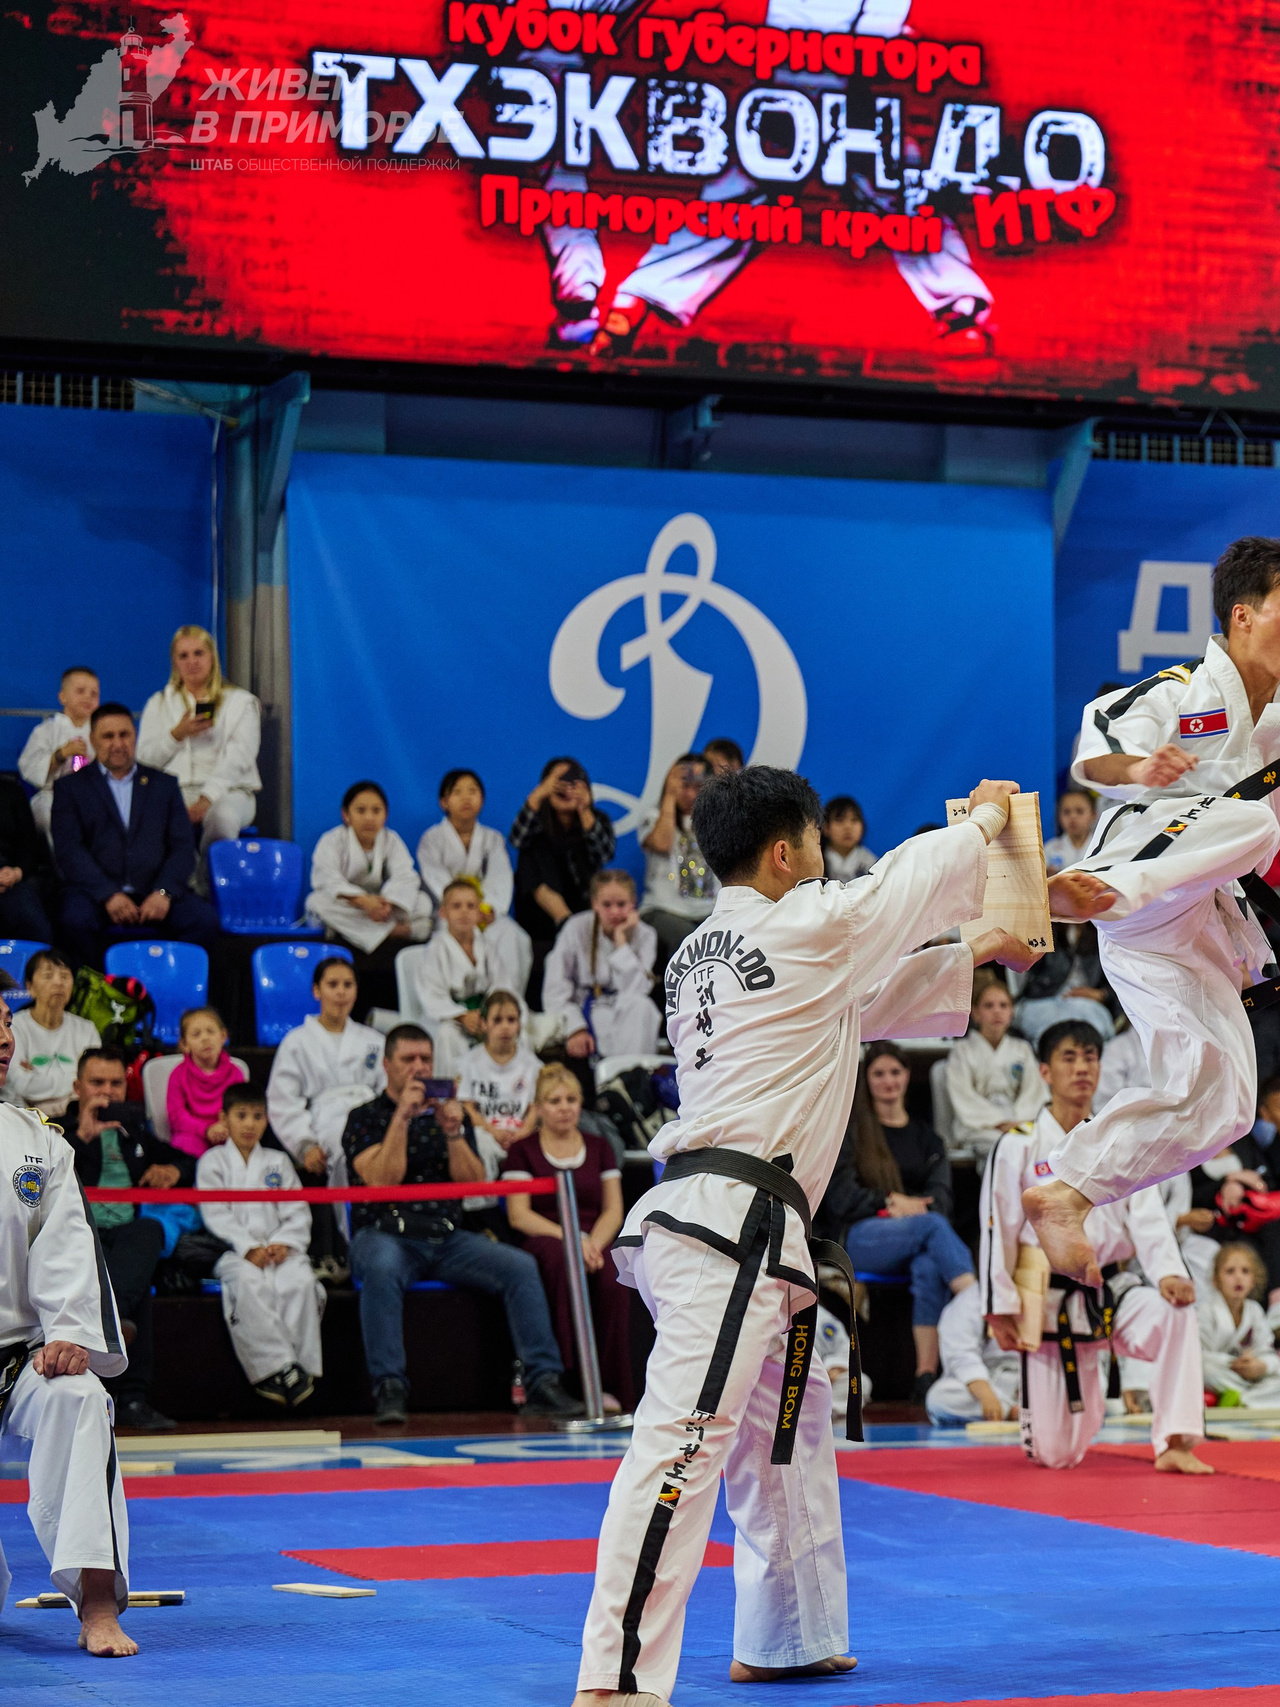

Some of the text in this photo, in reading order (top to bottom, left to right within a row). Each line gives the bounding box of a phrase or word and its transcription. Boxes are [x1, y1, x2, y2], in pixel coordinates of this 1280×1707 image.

[638, 14, 982, 91] губернатора
[312, 51, 1107, 212] ТХЭКВОНДО
[481, 175, 1117, 258] Приморский край ИТФ
[693, 965, 715, 984] ITF
[24, 1154, 43, 1164] ITF
[781, 1324, 809, 1429] HONG BOM
[691, 1409, 716, 1423] ITF
